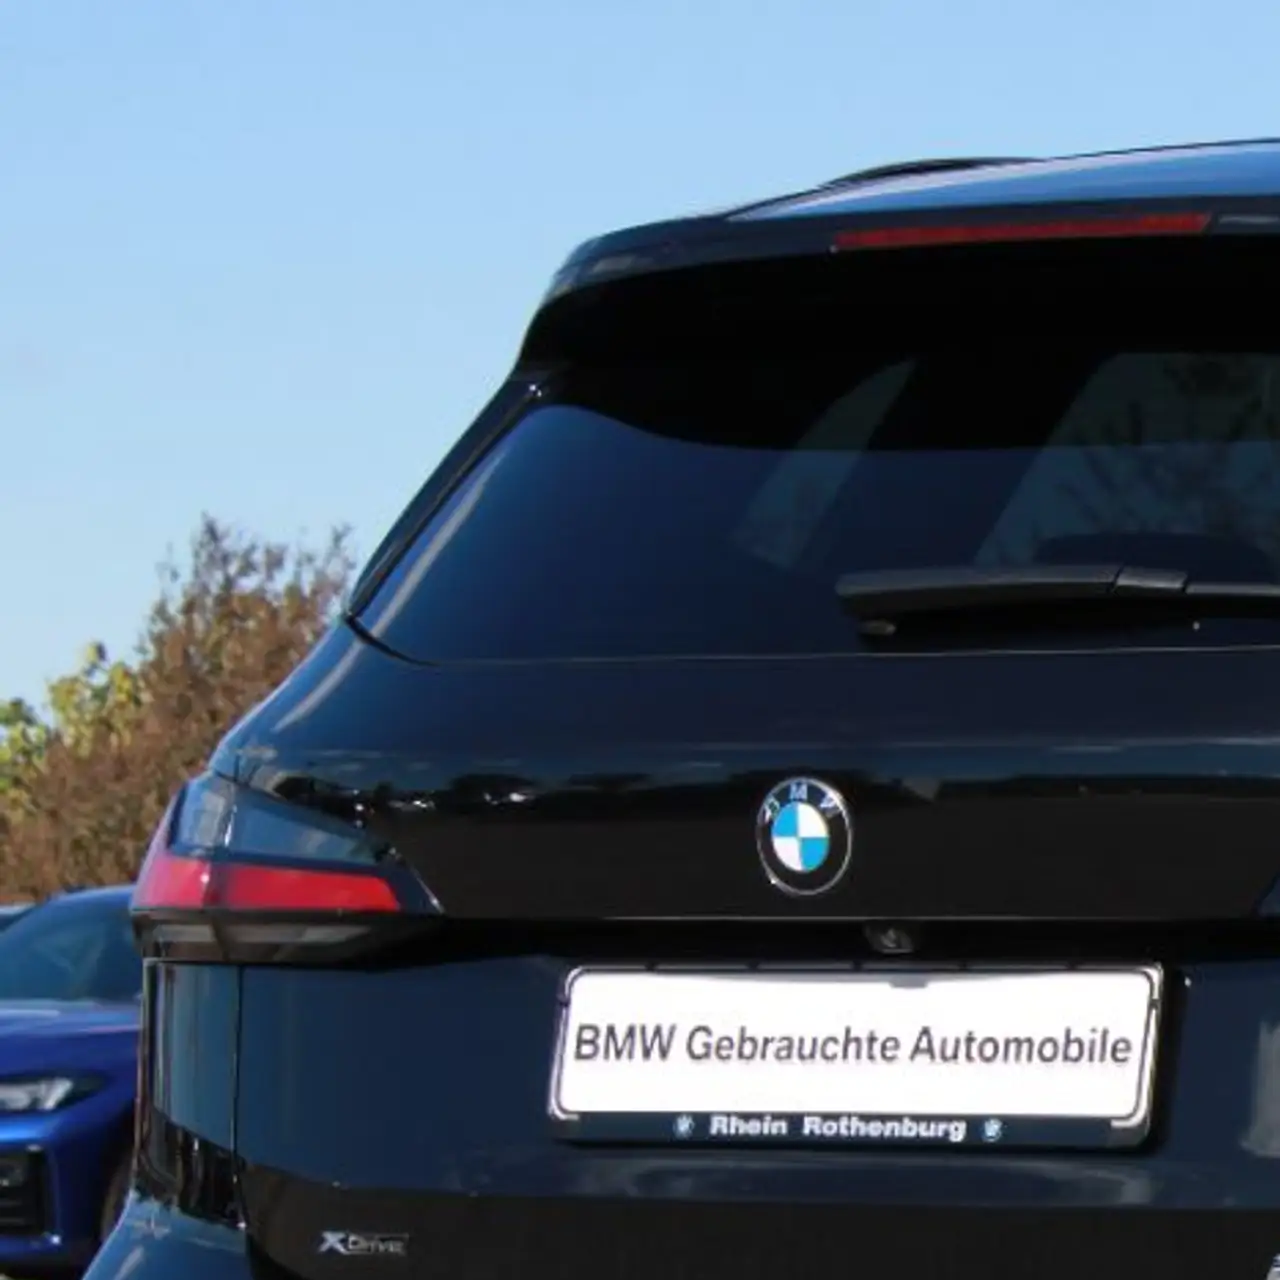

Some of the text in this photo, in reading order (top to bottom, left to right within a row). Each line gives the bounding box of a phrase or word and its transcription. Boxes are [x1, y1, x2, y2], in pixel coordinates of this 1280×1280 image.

[573, 1022, 1133, 1065] BMW Gebrauchte Automobile
[708, 1114, 968, 1143] Rhein Rothenburg
